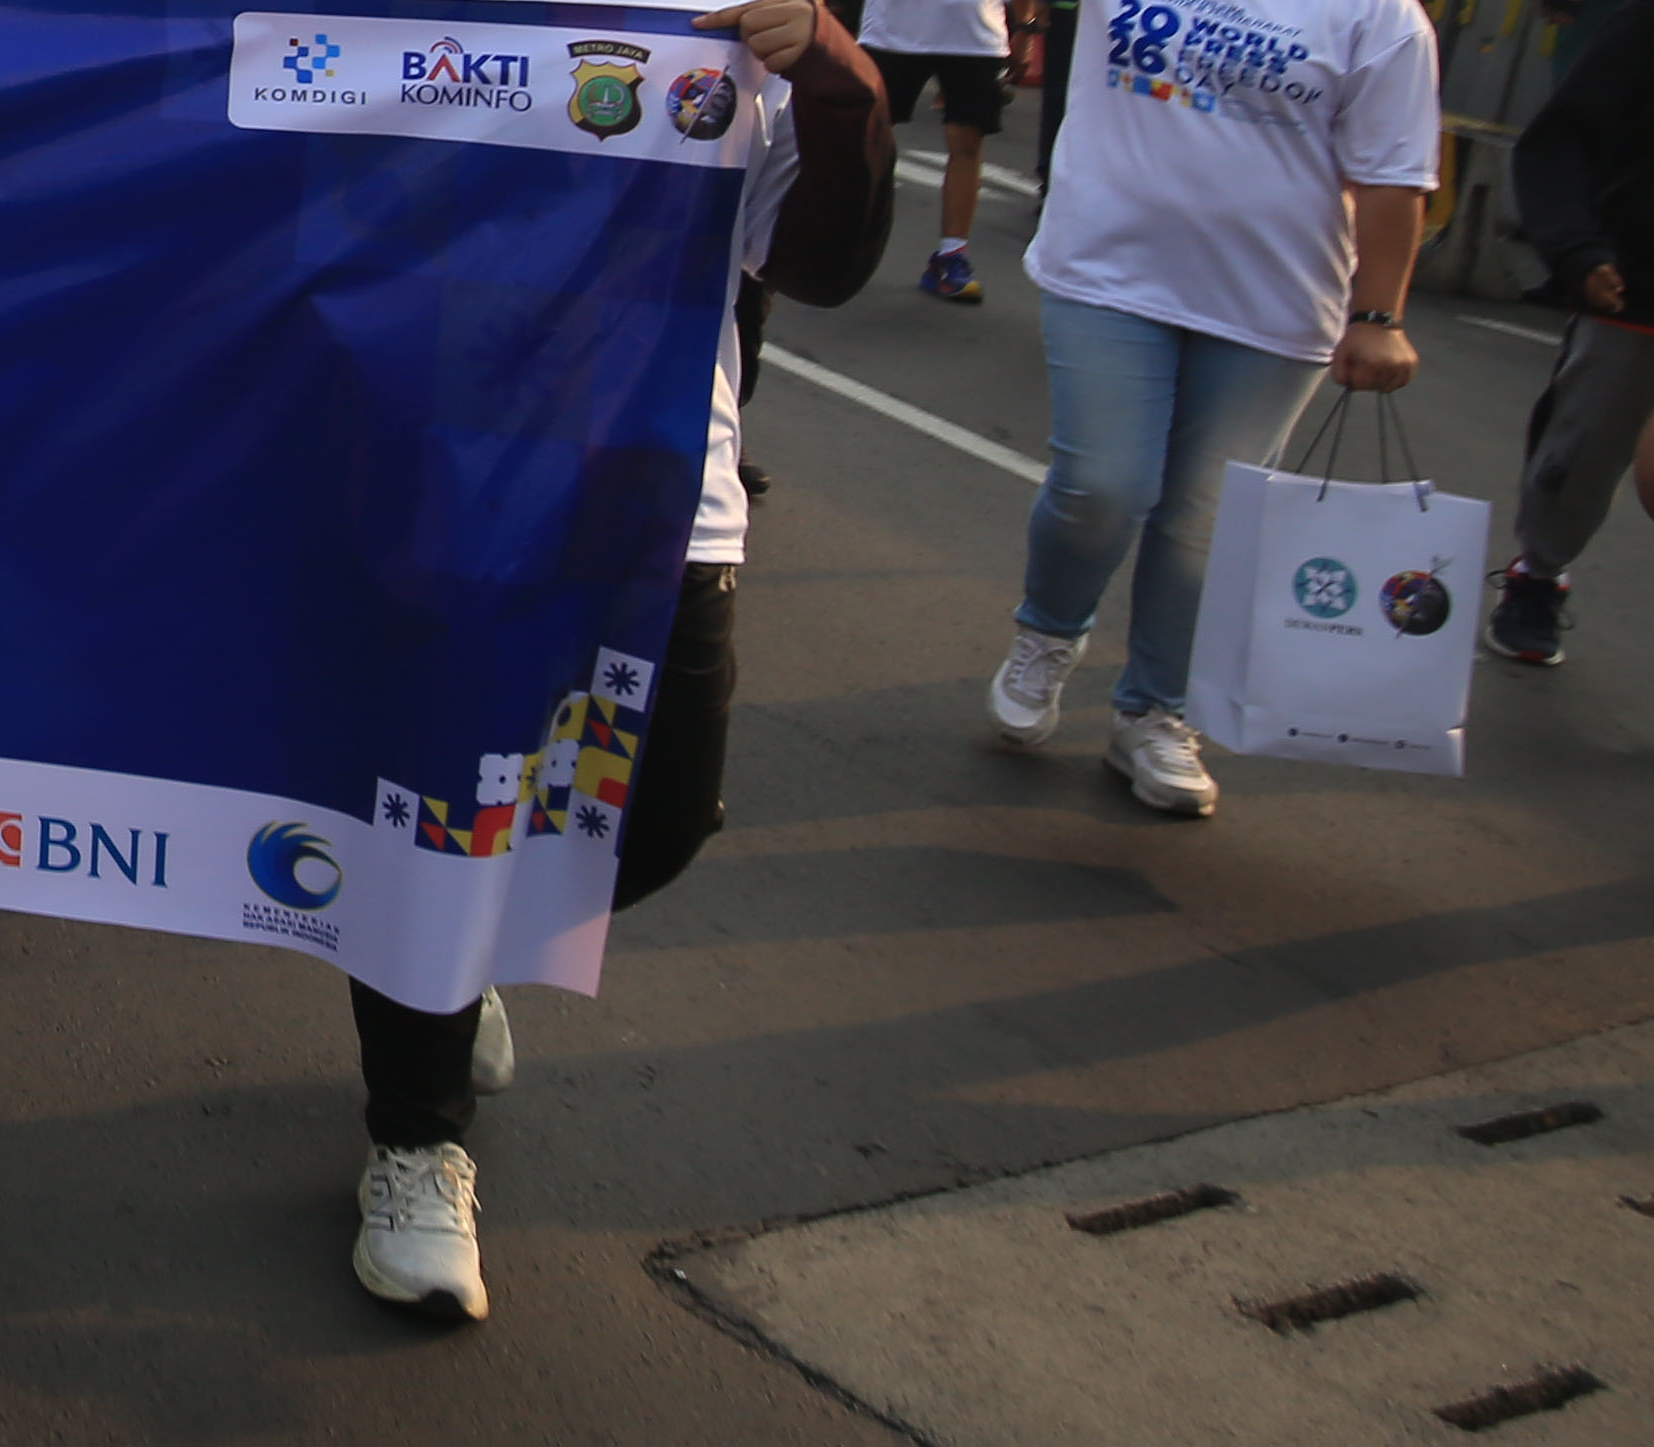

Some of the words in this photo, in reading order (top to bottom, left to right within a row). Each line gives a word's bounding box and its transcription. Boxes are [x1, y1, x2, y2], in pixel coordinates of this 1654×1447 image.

[616, 45, 644, 58] JAYA
[1108, 32, 1168, 74] 26
[402, 51, 530, 88] BAKTI
[254, 87, 367, 106] KOMDIGI
[400, 83, 532, 112] KOMINFO
[35, 814, 171, 889] BNI
